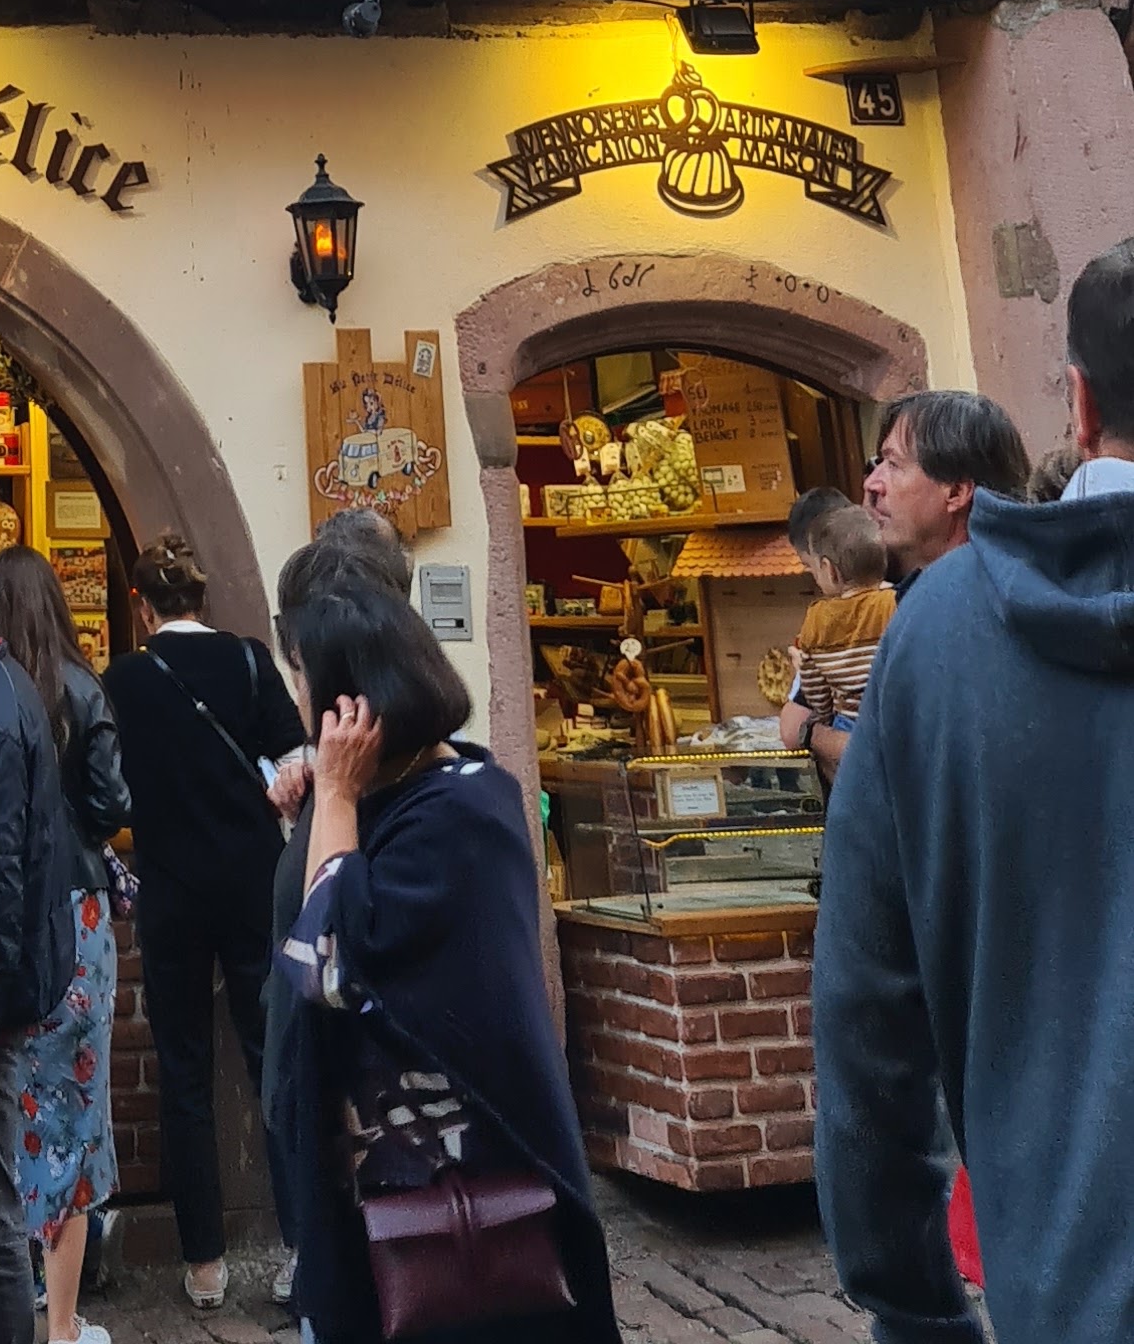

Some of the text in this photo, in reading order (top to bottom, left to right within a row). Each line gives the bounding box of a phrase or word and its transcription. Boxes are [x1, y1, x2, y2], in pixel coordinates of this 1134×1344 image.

[857, 83, 896, 117] 45
[518, 103, 849, 162] VIENNOISERIES ARTISANALES
[530, 134, 840, 186] FABRICATION MAISON
[350, 370, 379, 388] Petit
[383, 372, 416, 394] Délice
[693, 418, 725, 432] LARD
[694, 428, 739, 444] BEIGNET
